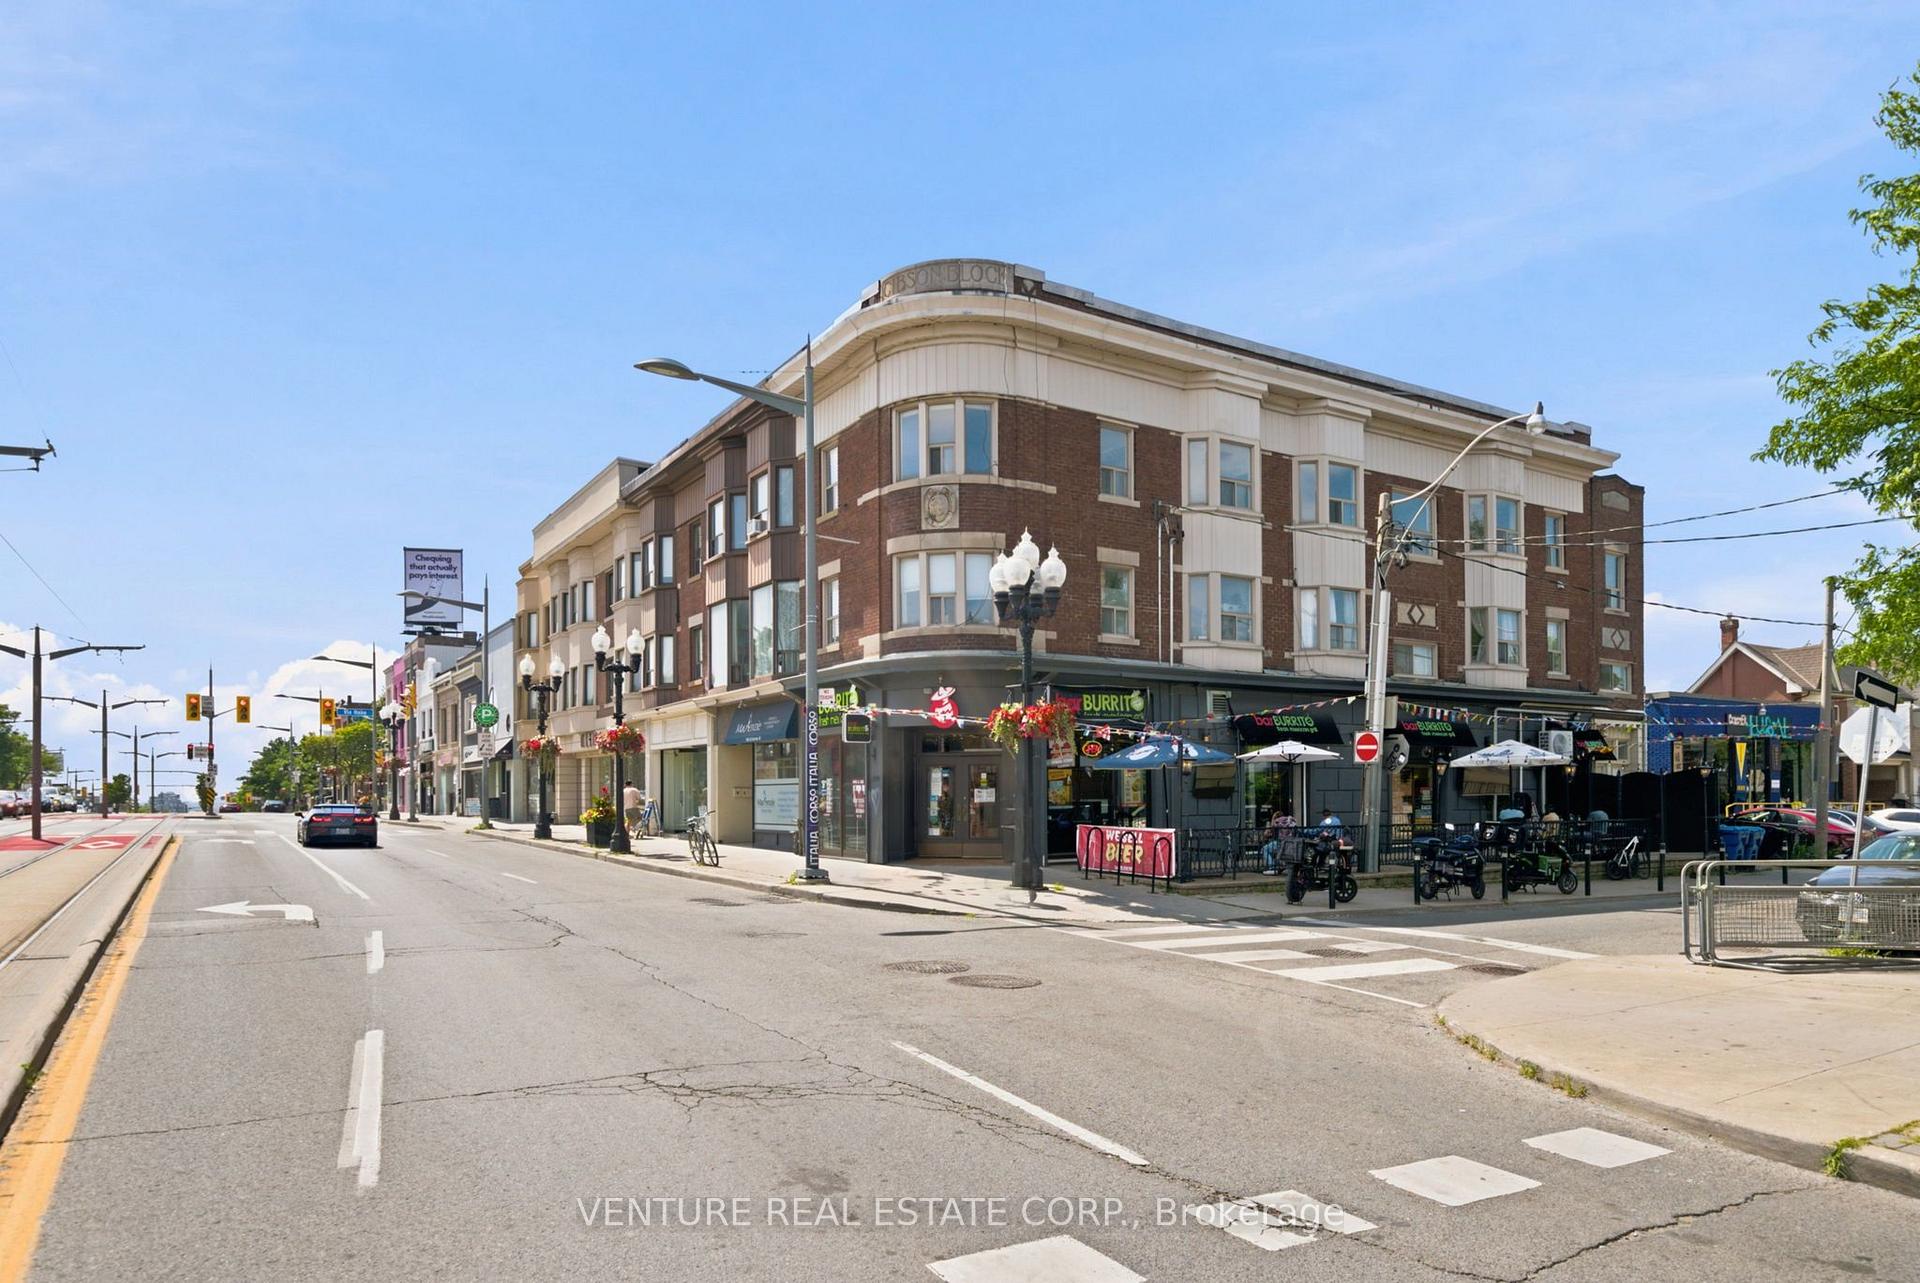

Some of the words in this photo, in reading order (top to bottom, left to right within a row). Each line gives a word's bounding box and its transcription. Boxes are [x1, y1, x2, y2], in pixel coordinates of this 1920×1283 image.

[883, 265, 942, 297] GIBSON
[947, 263, 1007, 284] BLOCK
[415, 554, 452, 564] Chequing
[428, 563, 457, 573] actually
[409, 572, 428, 580] pays
[809, 711, 818, 745] CORSO
[809, 752, 818, 786] ITALIA
[809, 789, 818, 824] CORSO
[809, 831, 818, 867] ITALIA
[1105, 829, 1120, 841] WE
[1105, 842, 1144, 864] BEER
